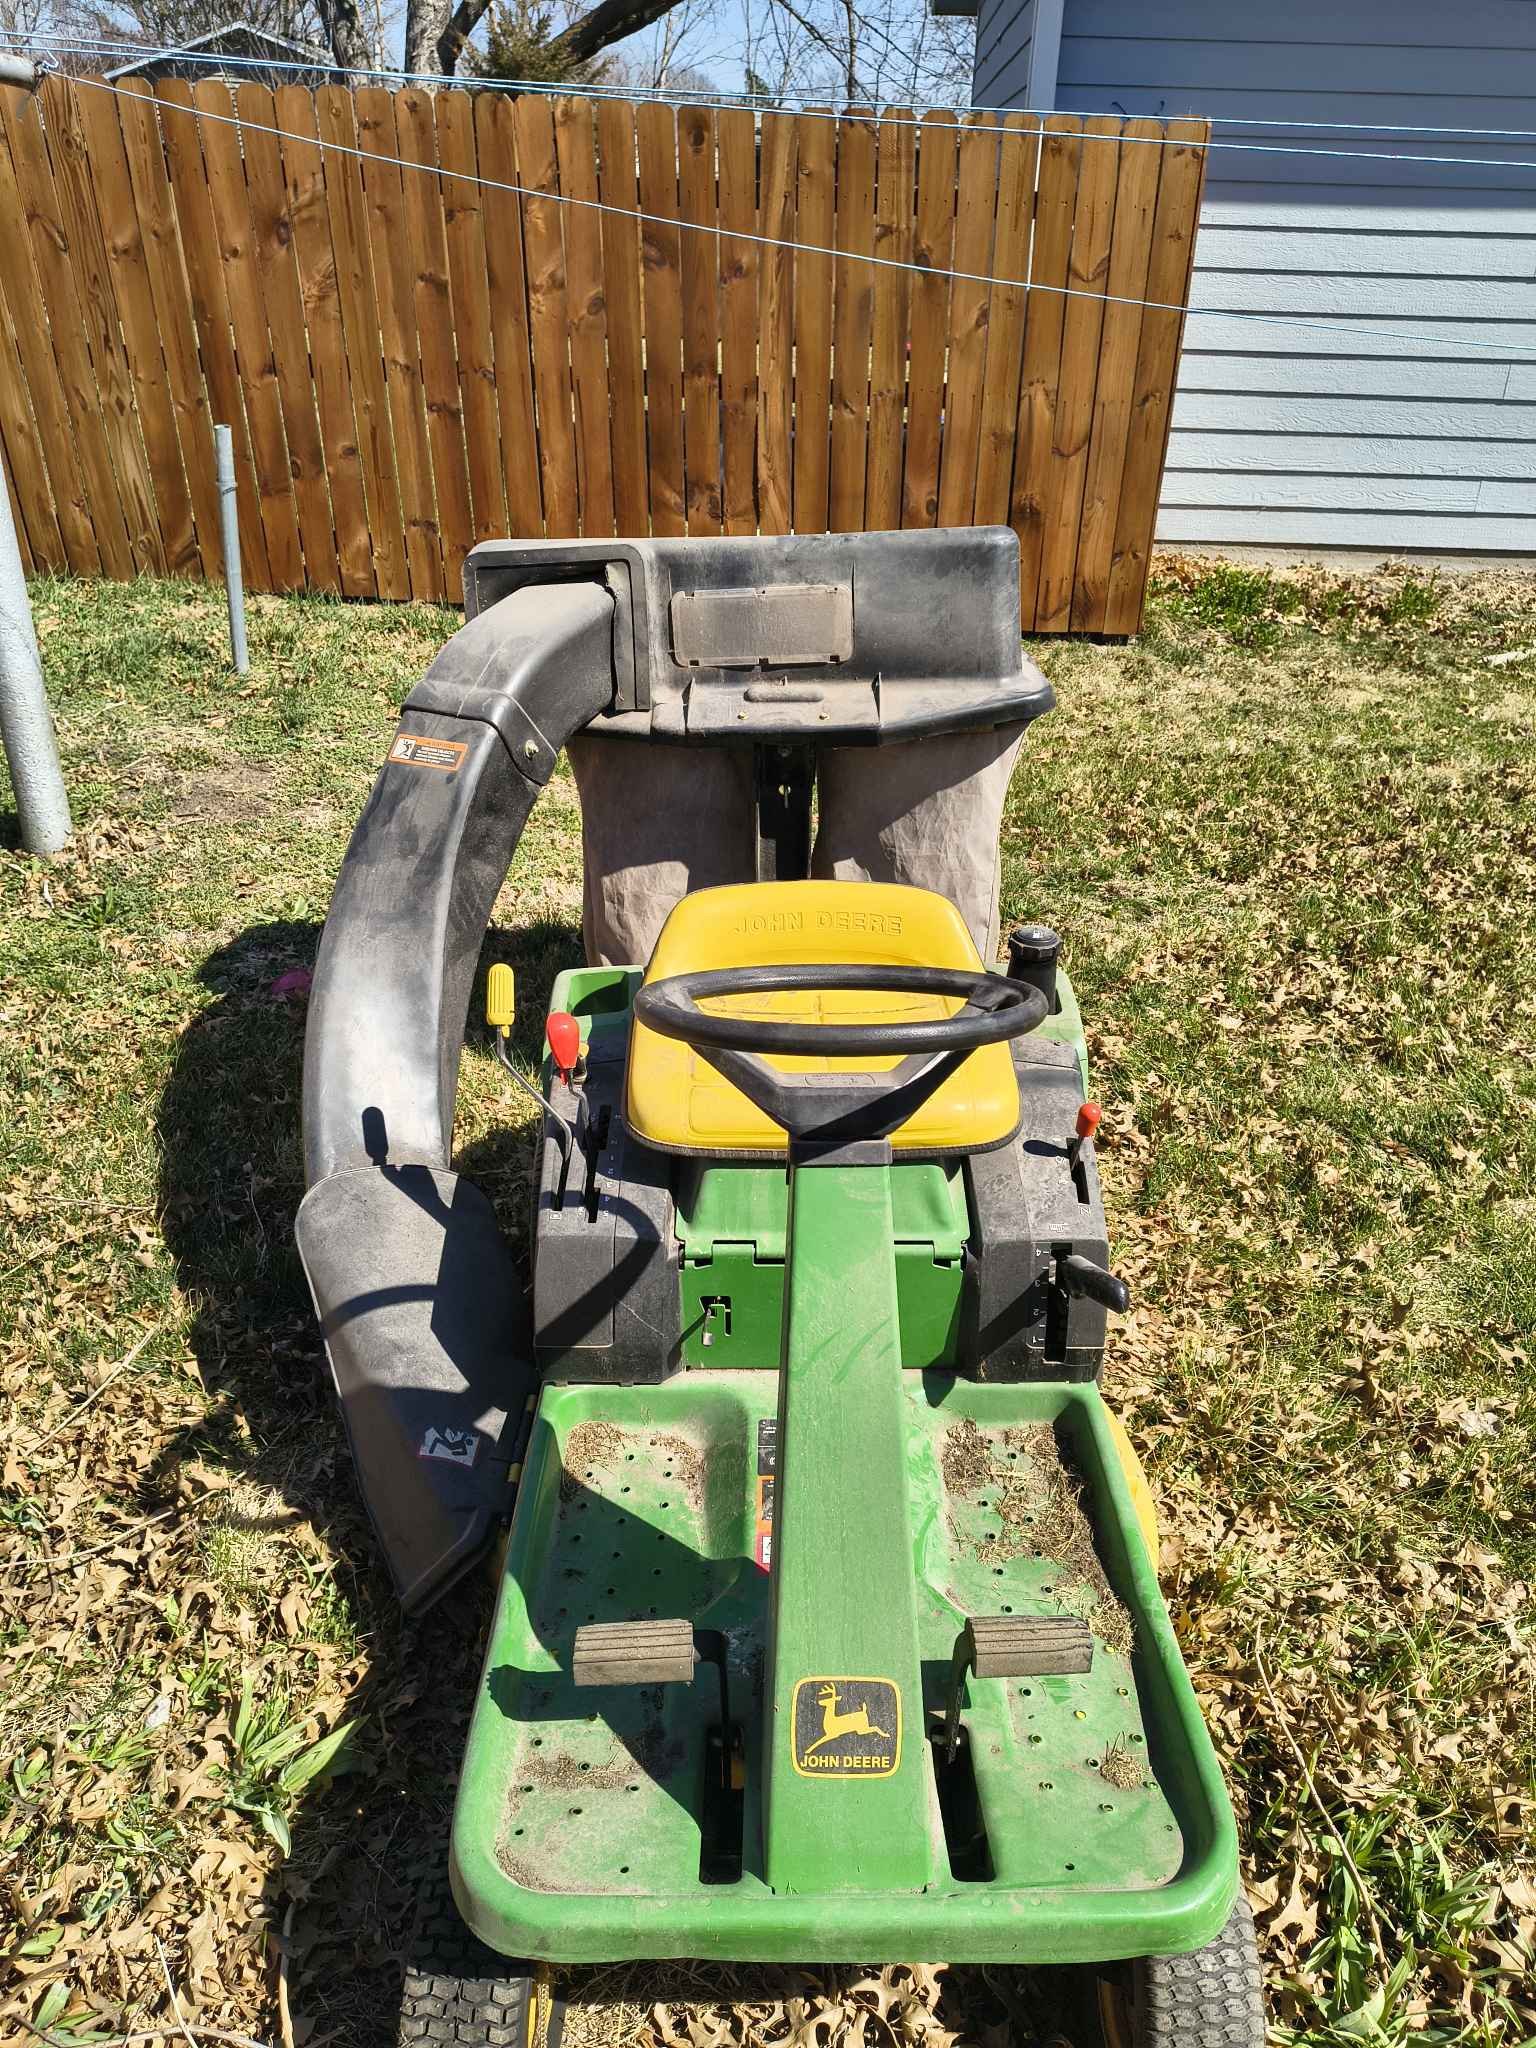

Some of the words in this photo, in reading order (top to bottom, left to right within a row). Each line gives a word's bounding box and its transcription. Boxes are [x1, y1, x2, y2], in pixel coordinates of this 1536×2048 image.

[734, 911, 804, 935] JOHN
[816, 911, 904, 937] DEERE
[1032, 1308, 1040, 1316] 2
[799, 1755, 840, 1769] JOHN
[843, 1756, 890, 1768] DEERE
